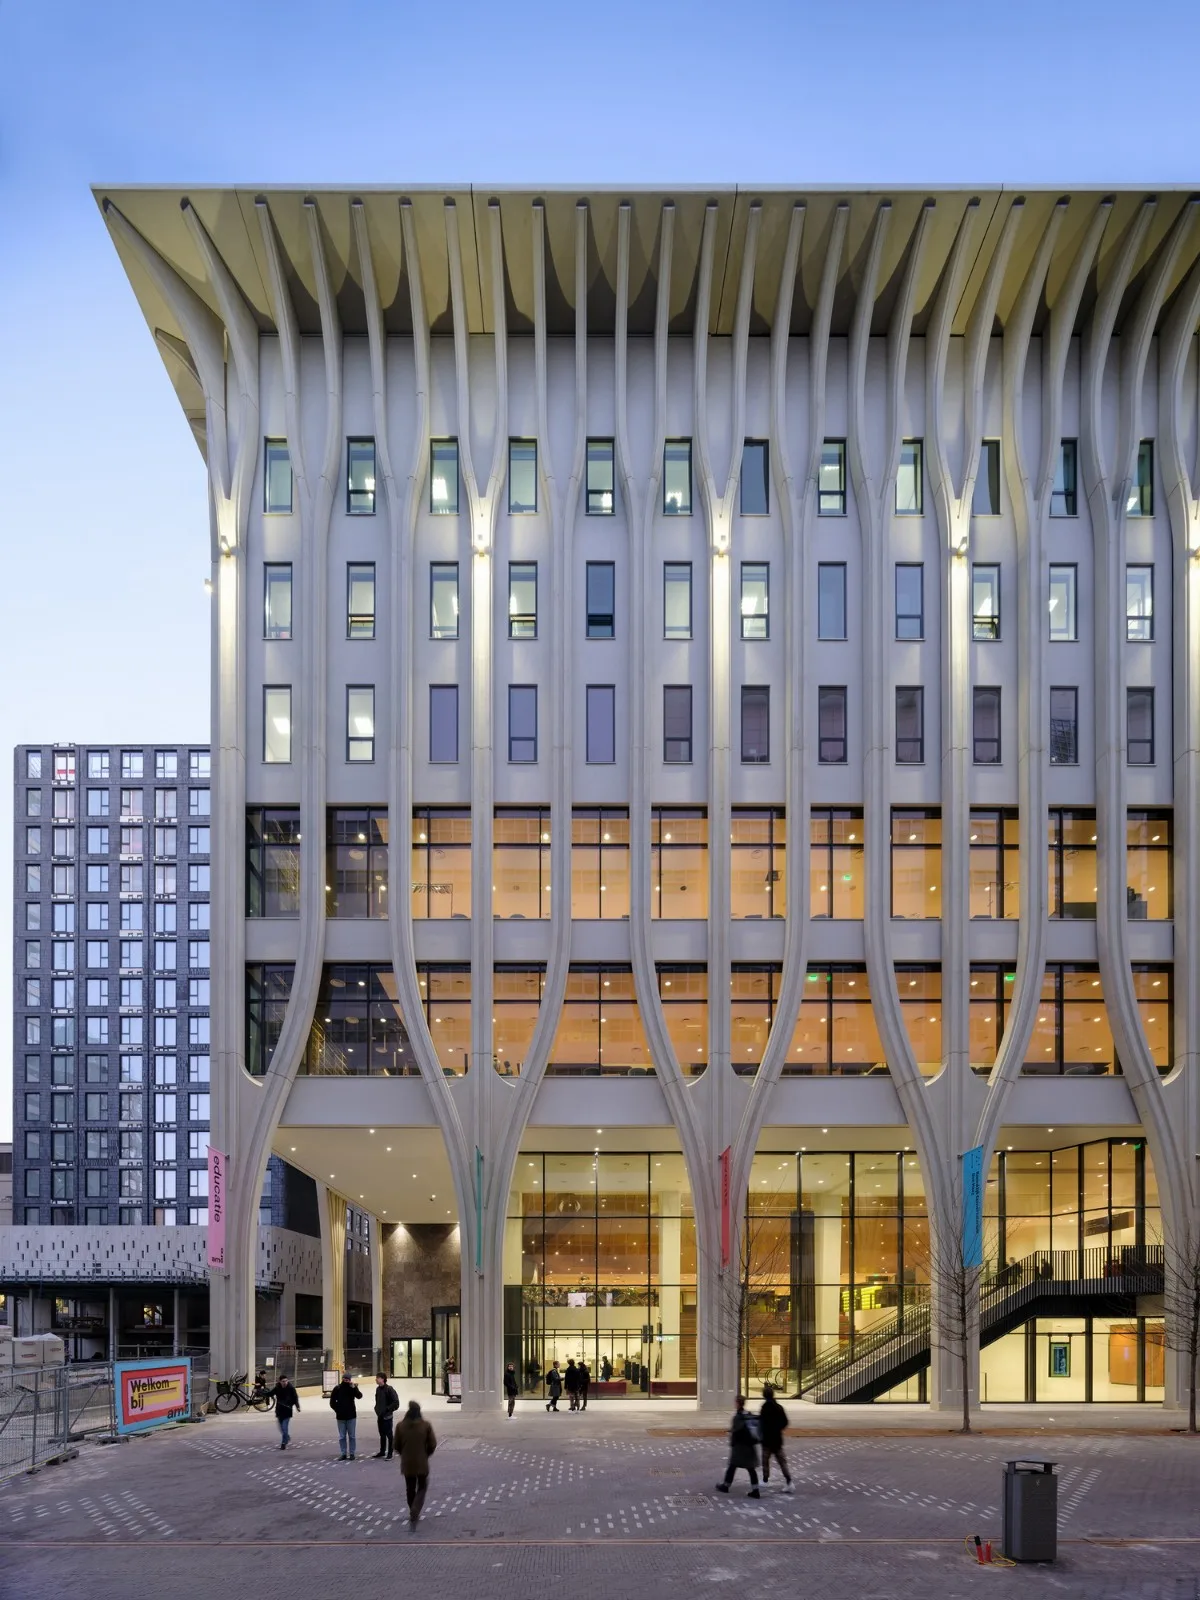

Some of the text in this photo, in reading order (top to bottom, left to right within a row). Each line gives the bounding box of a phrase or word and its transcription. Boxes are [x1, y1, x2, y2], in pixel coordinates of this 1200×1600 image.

[213, 1155, 223, 1223] educatie
[130, 1378, 170, 1393] Welkom
[130, 1395, 144, 1411] bij
